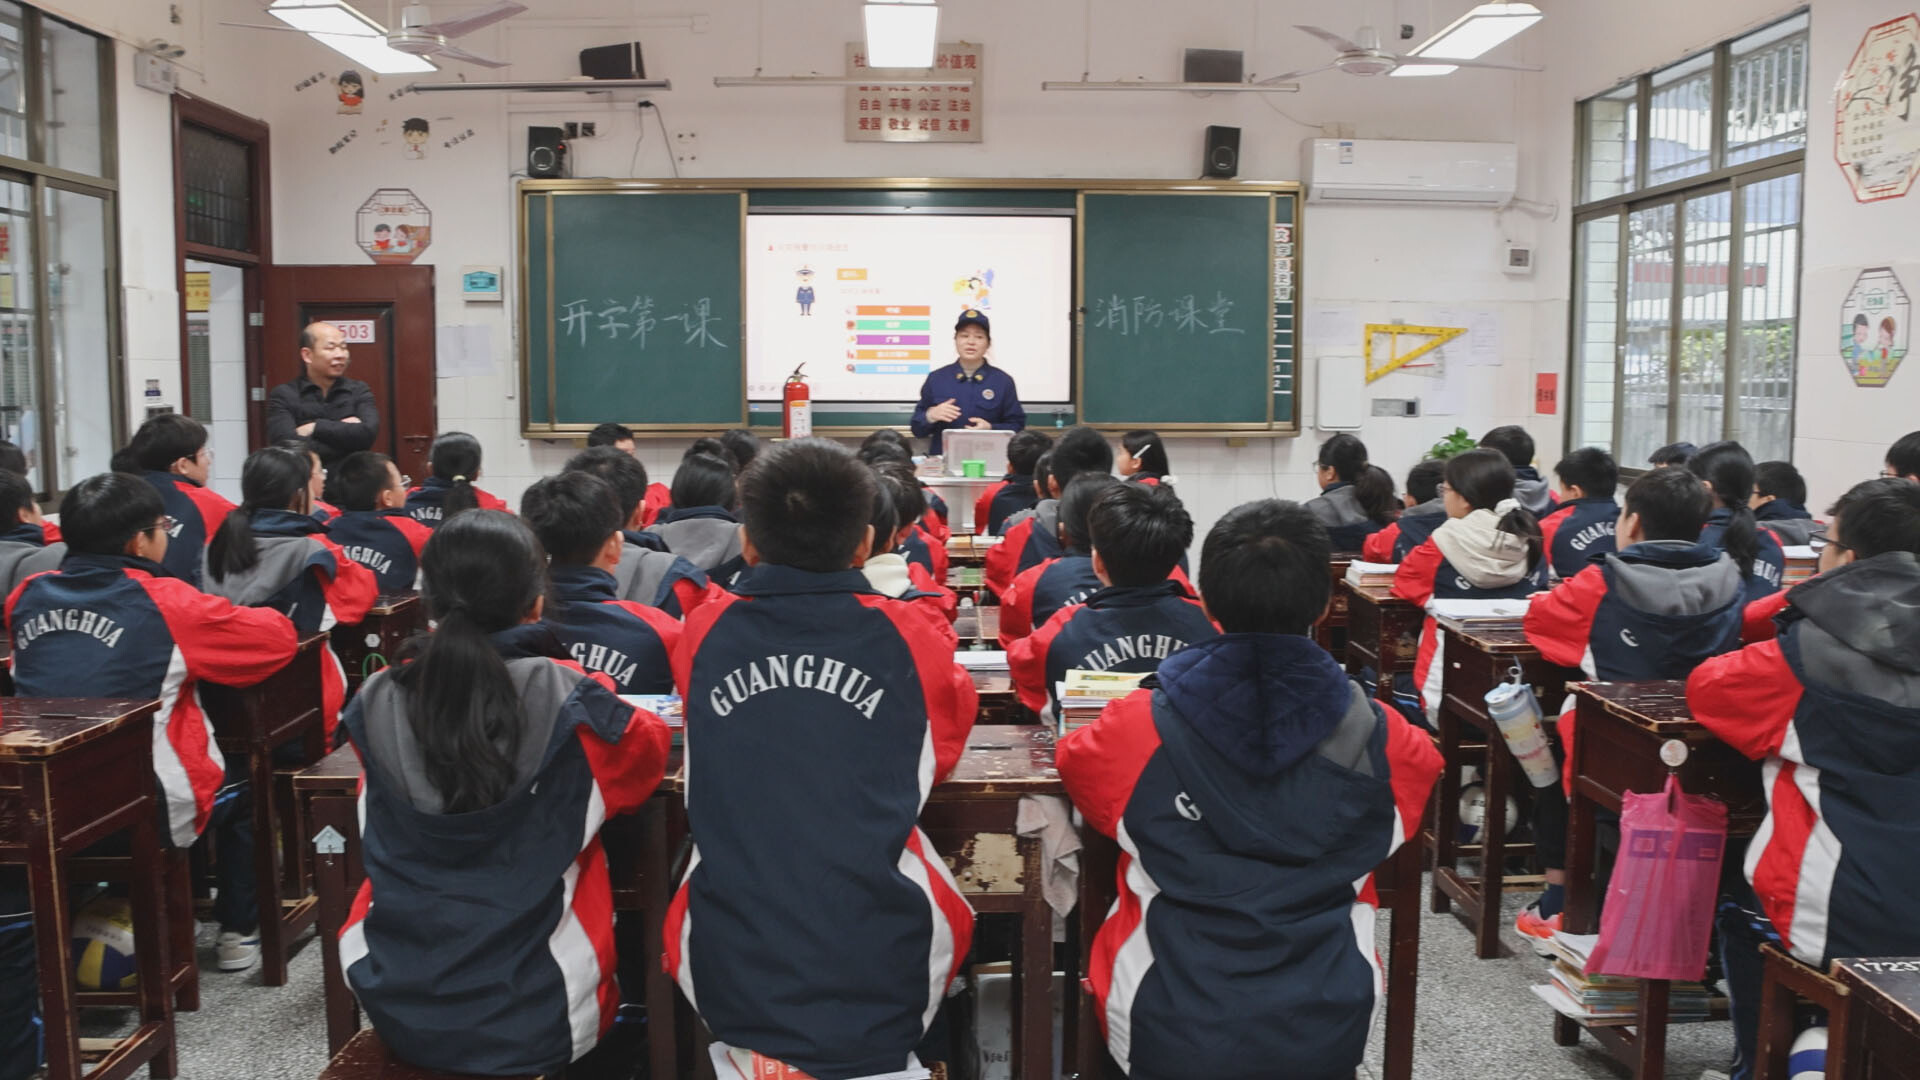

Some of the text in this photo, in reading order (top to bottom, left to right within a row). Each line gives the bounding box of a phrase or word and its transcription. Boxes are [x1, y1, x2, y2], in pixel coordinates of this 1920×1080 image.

[858, 117, 881, 130] 爱国
[888, 117, 911, 131] 敬业
[918, 118, 941, 131] 诚信
[859, 98, 881, 111] 自由
[888, 98, 911, 111] 平等
[918, 99, 941, 111] 公正
[1095, 291, 1245, 335] 消防课堂
[1570, 521, 1616, 551] GUANG
[17, 608, 125, 650] GUANGHUA
[568, 642, 638, 687] GHUA
[1075, 634, 1190, 672] UANGH
[710, 654, 885, 720] GUANGHUA
